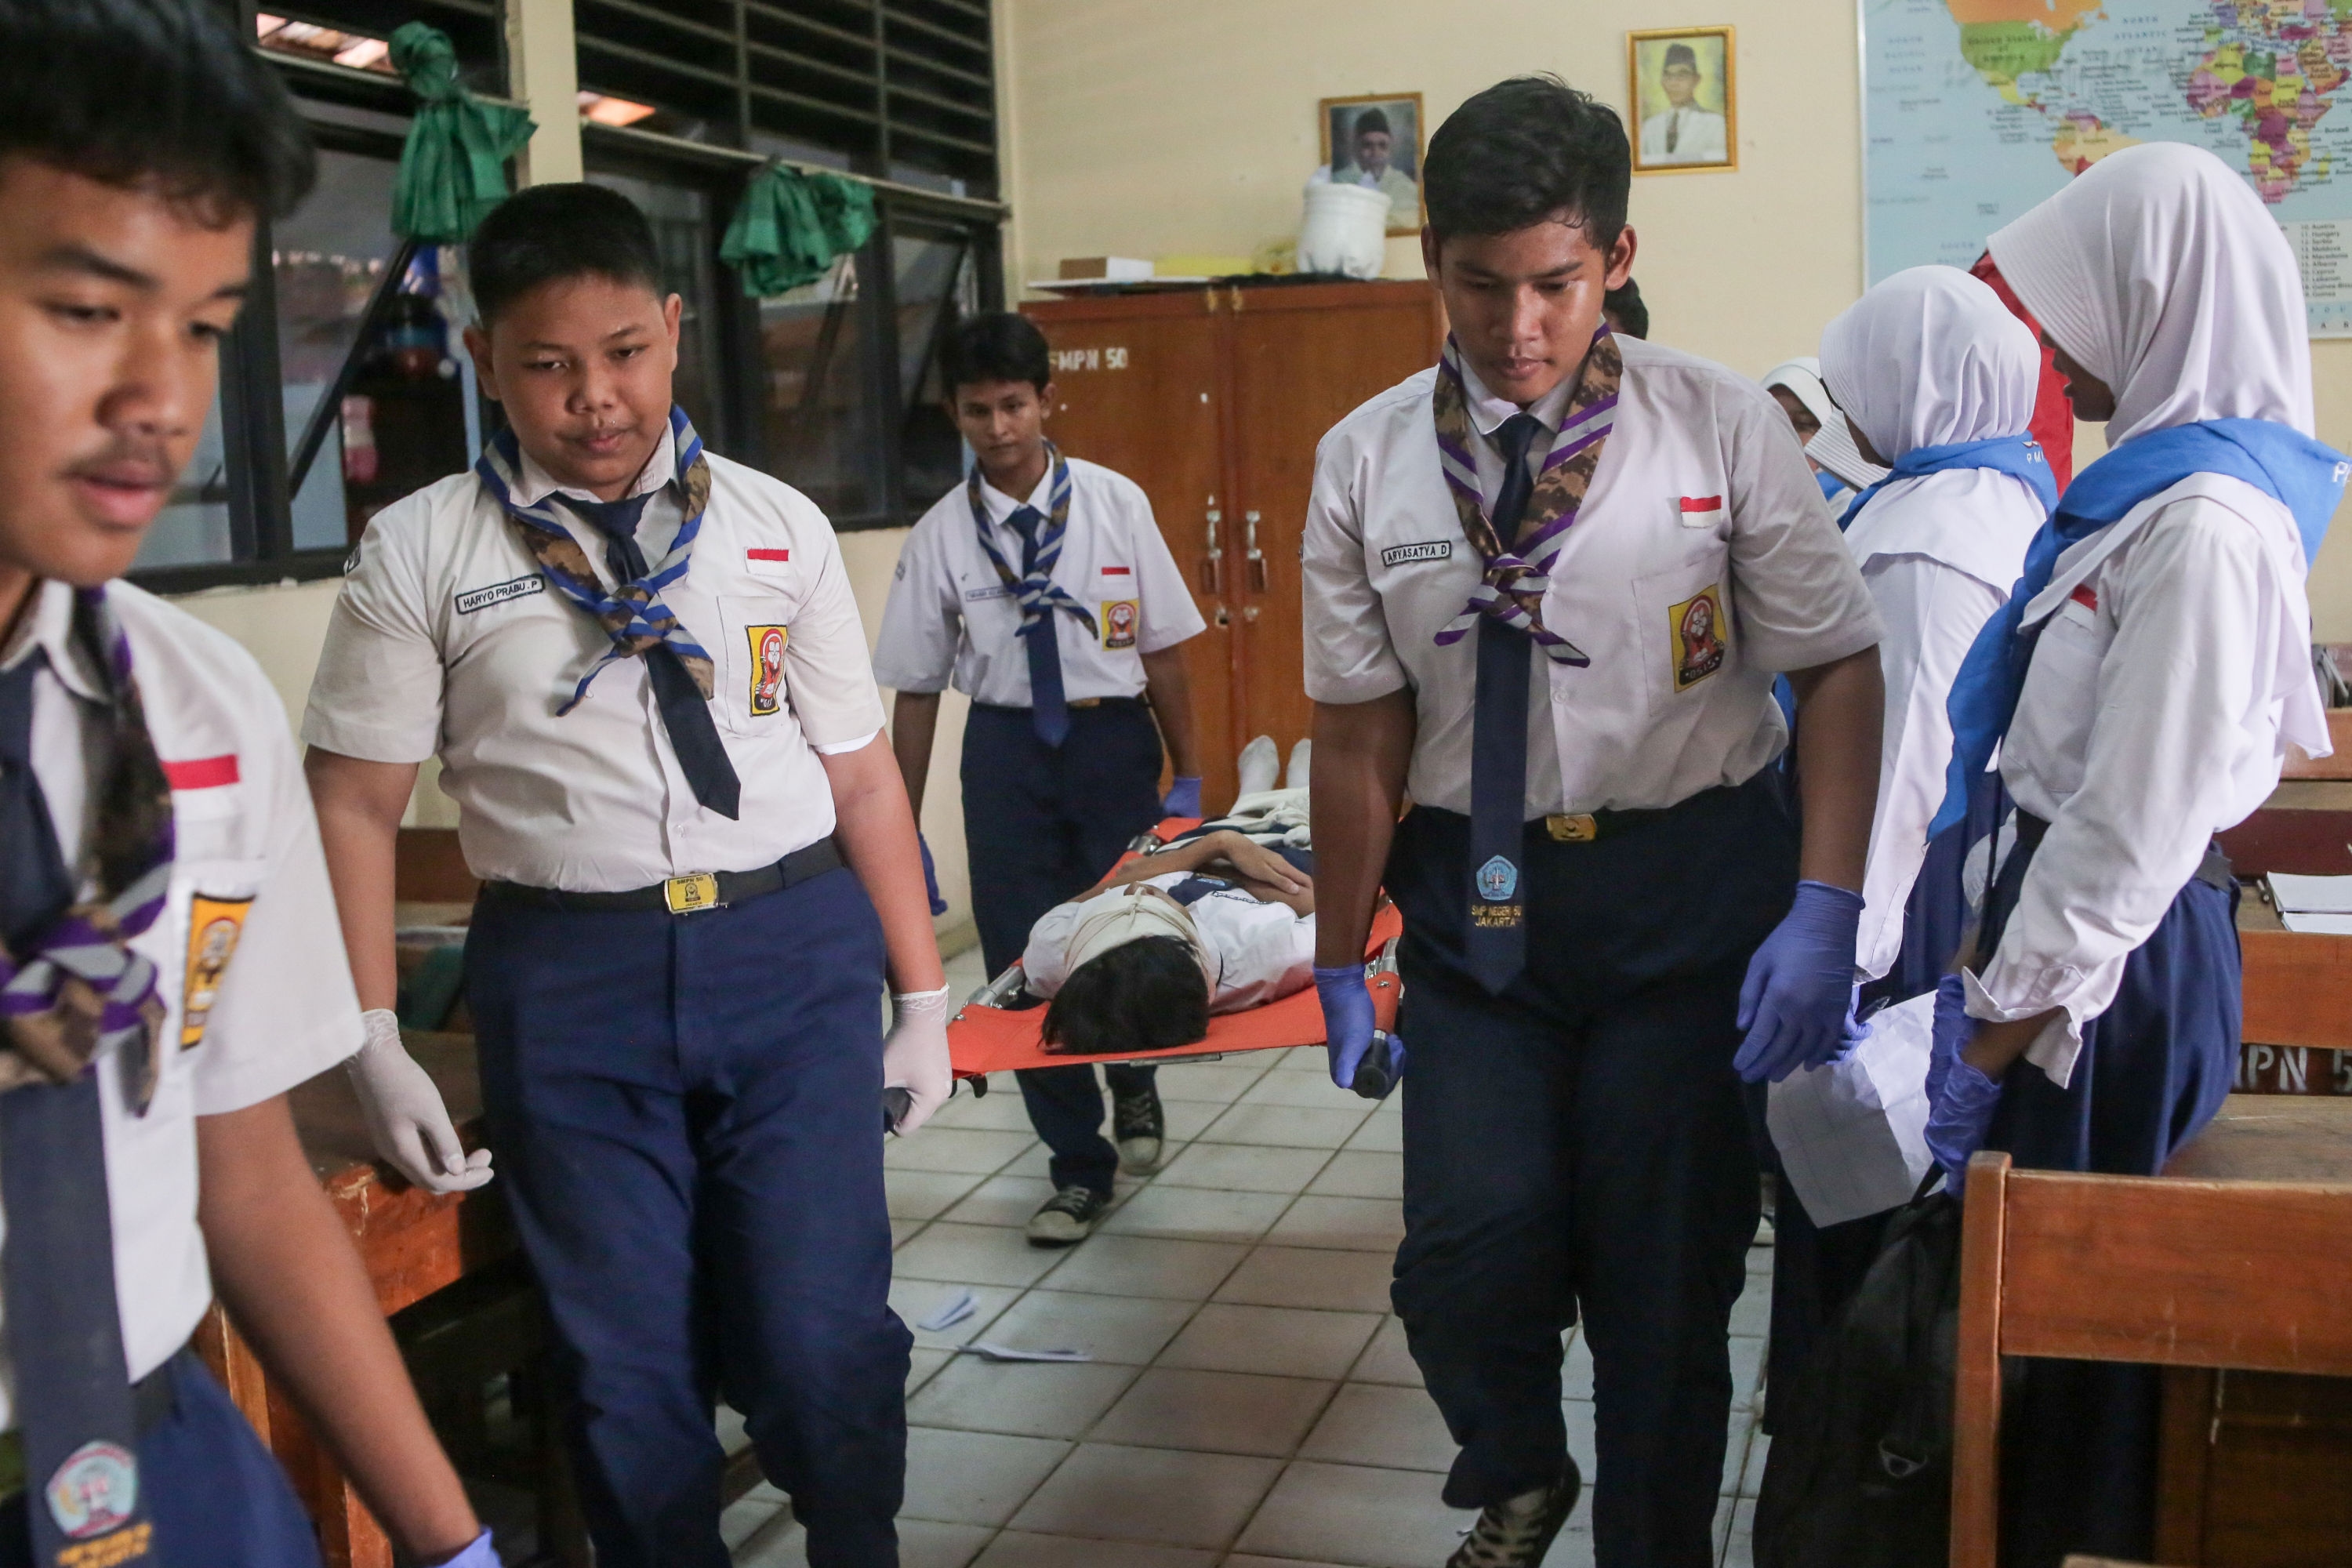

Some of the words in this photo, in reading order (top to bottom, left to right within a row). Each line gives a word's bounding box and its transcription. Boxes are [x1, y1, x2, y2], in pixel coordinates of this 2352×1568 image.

[2122, 16, 2158, 24] NORTH
[1106, 347, 1128, 370] 50
[1388, 546, 1436, 562] ARYASATYA
[1441, 545, 1447, 554] D
[463, 590, 494, 608] HARYO
[496, 583, 525, 597] PRABU
[532, 580, 538, 589] P
[1475, 916, 1516, 927] JAKARTA
